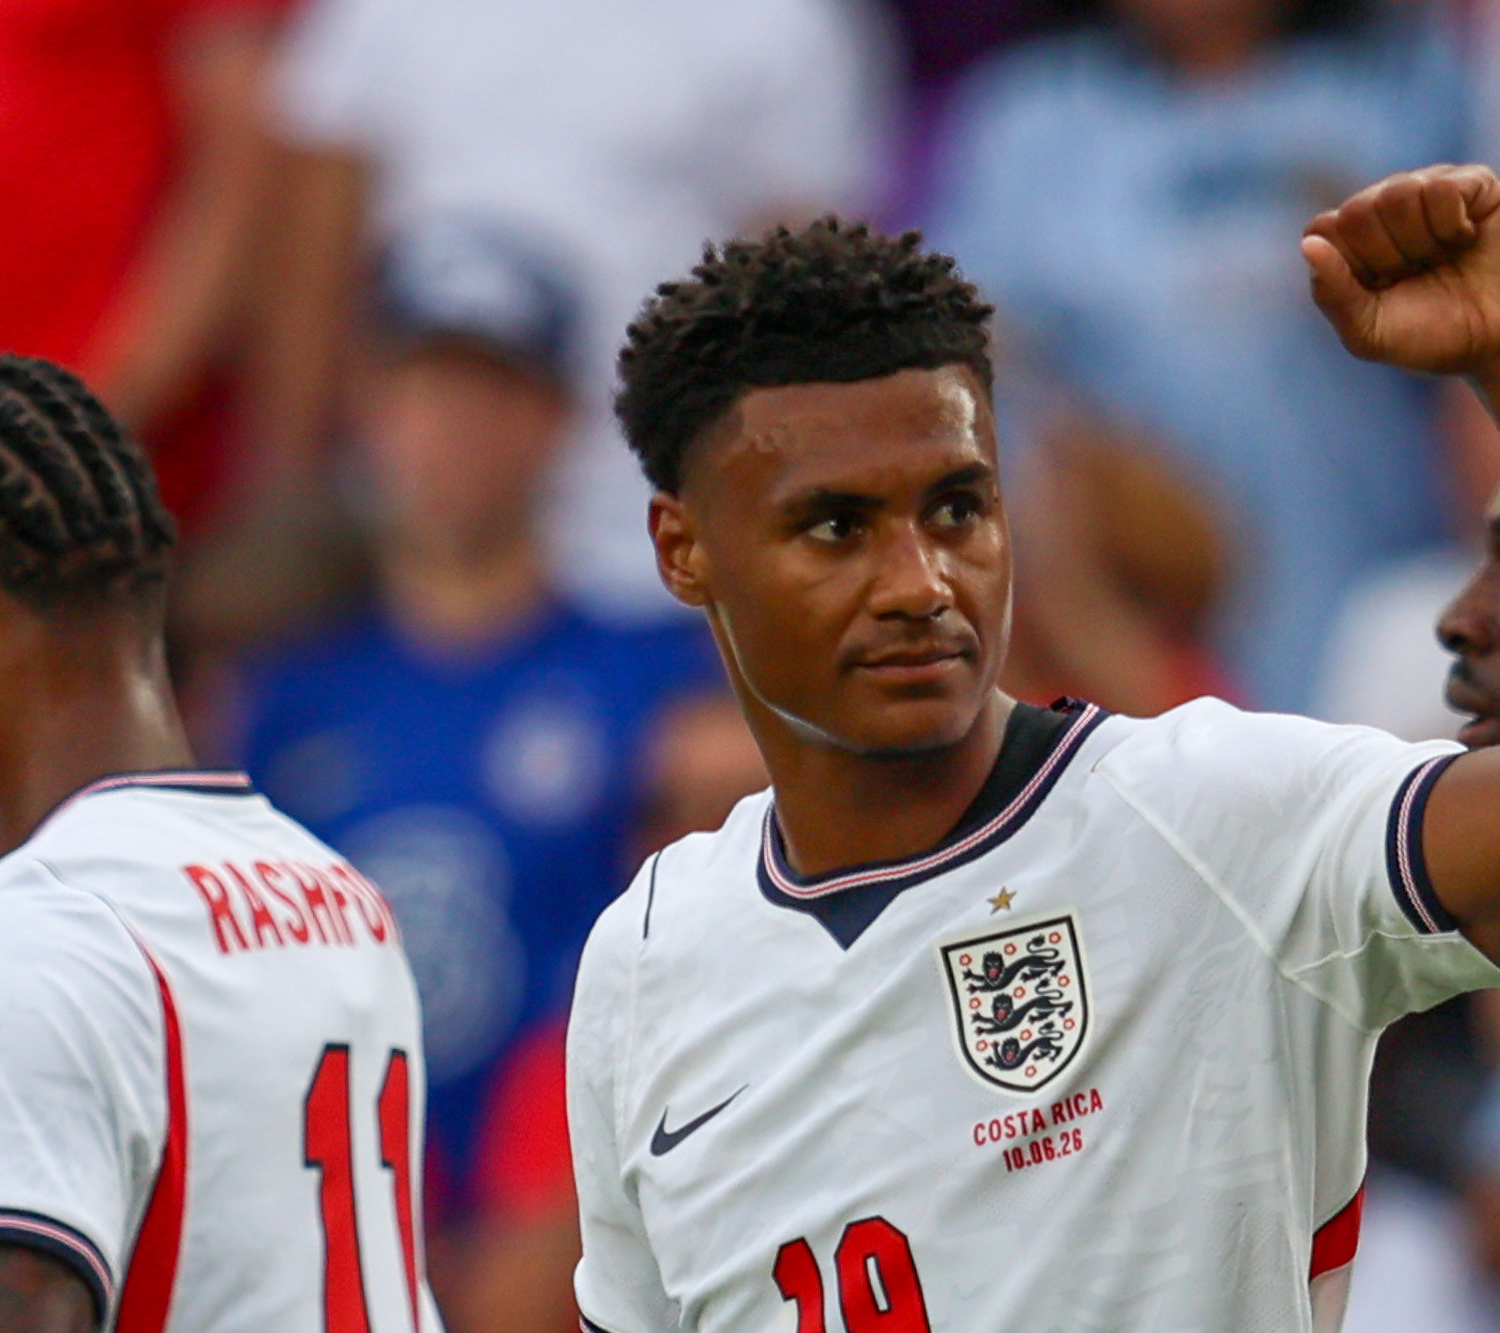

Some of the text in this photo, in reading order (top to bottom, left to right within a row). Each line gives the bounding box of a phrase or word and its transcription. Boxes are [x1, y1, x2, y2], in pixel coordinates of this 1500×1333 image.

[973, 1087, 1104, 1146] COSTA RICA
[1002, 1127, 1084, 1172] 10.06.26
